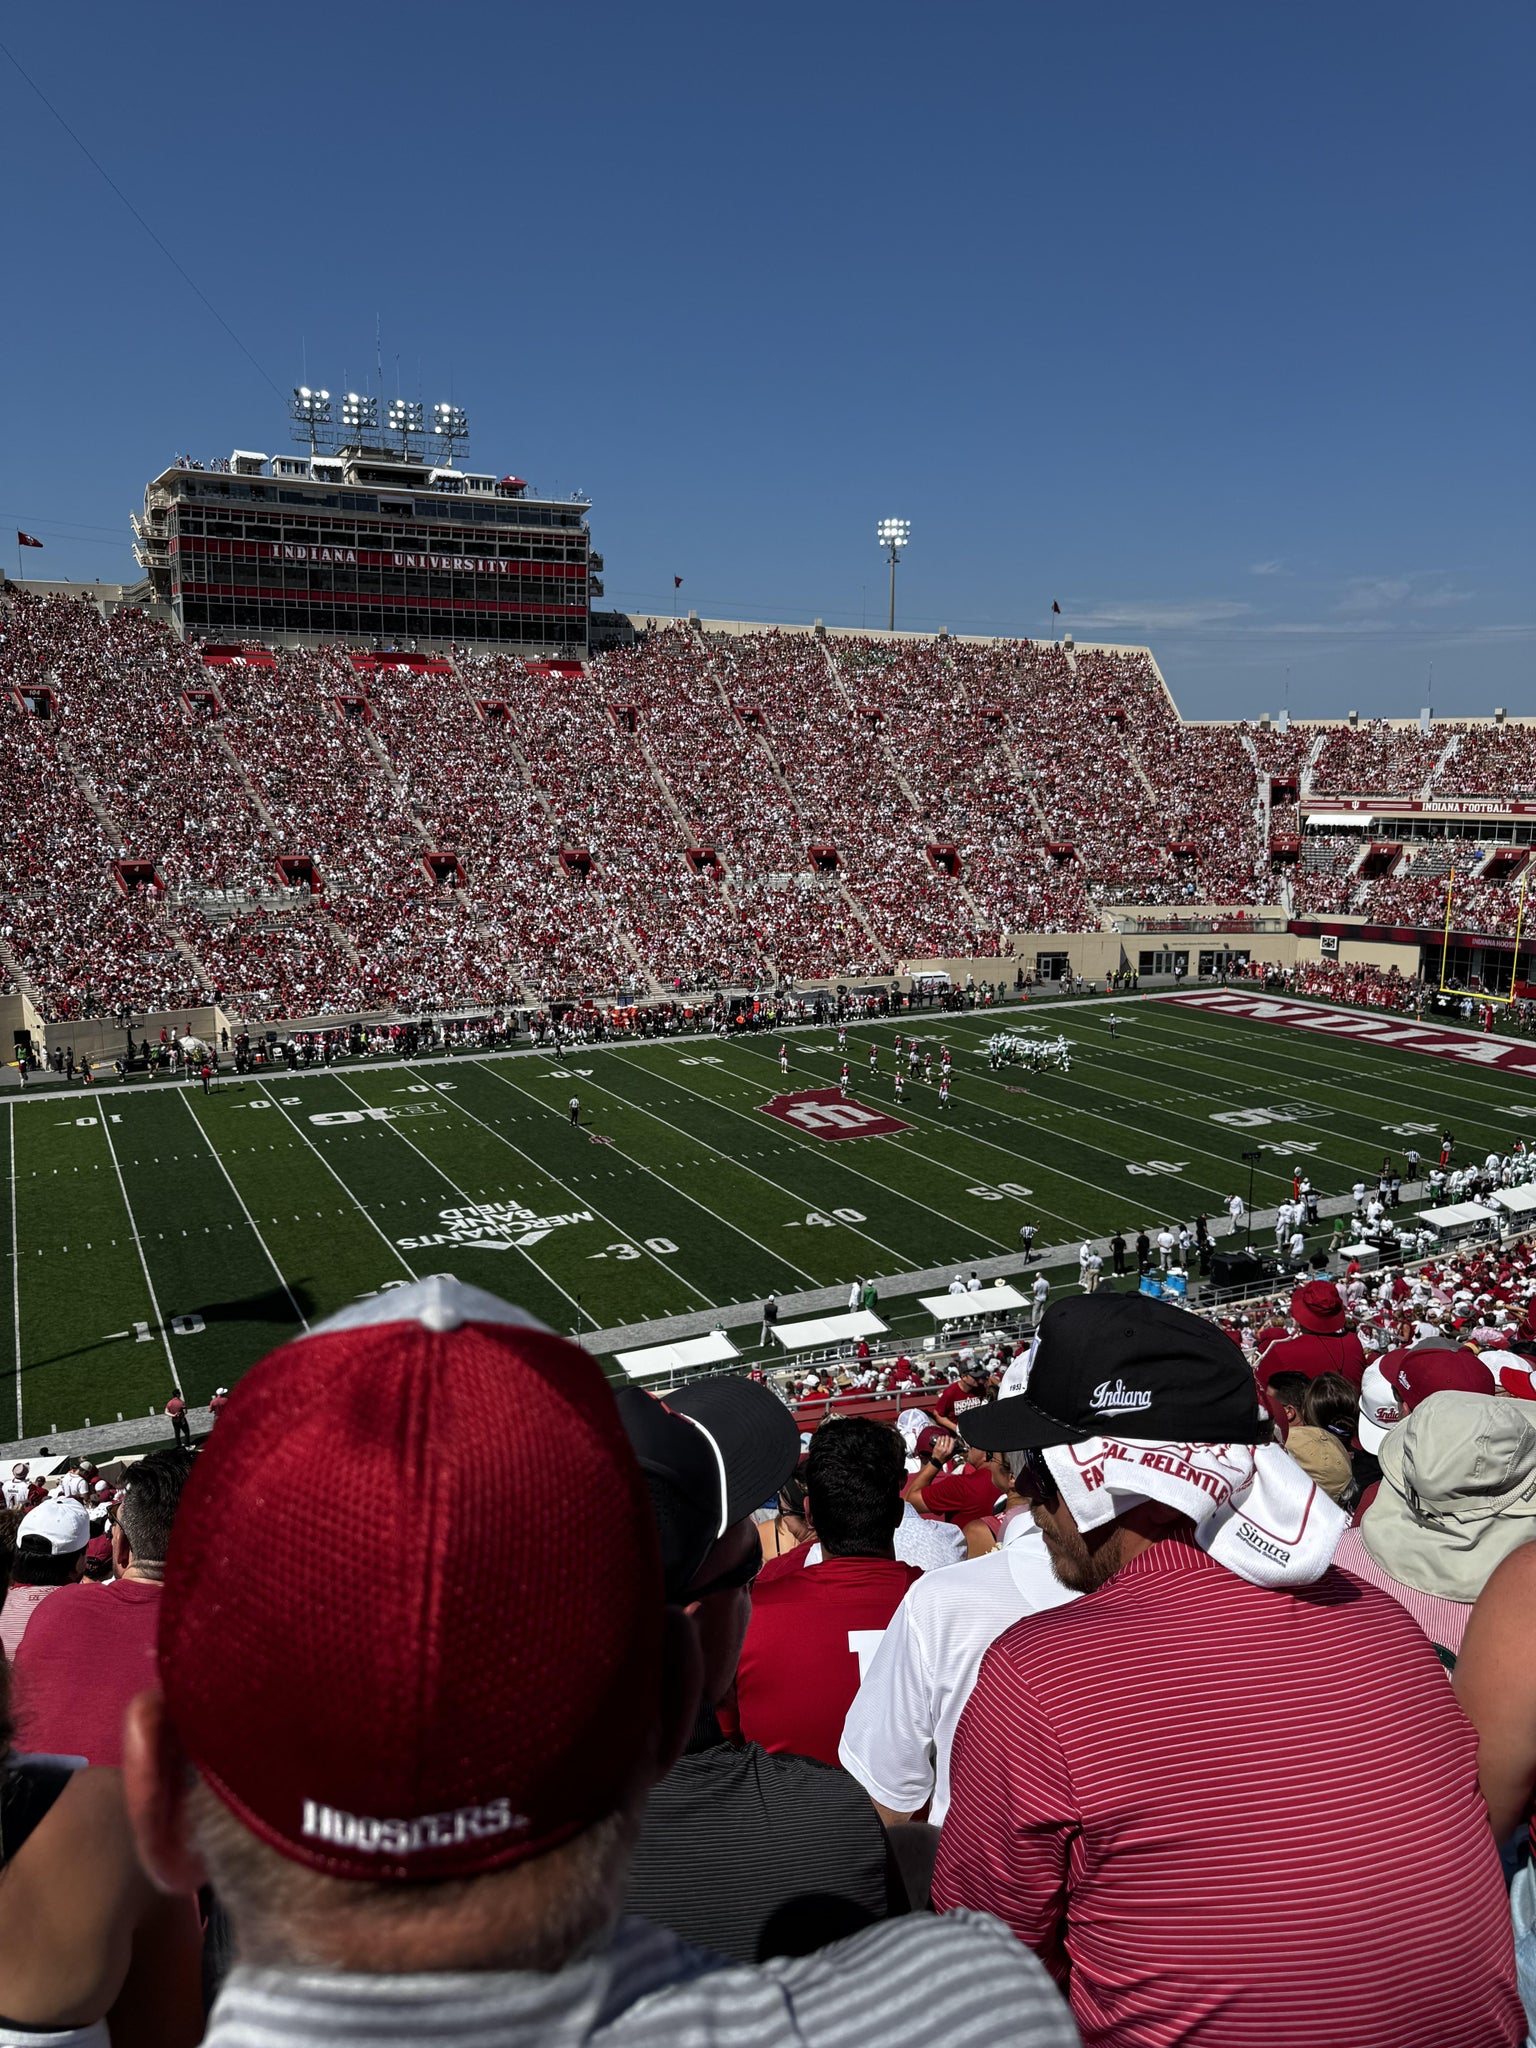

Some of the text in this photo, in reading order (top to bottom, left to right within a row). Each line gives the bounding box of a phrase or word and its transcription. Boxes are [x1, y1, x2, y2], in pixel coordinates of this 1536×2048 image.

[272, 544, 510, 573] INDIANA UNIVERSITY
[1422, 802, 1512, 813] INDIANA FOOTBALL
[1323, 938, 1335, 948] 25
[1472, 938, 1495, 947] INDIANA
[1175, 995, 1536, 1073] INDIA
[678, 1056, 724, 1065] 50
[550, 1069, 593, 1078] 40
[407, 1082, 458, 1093] 30
[249, 1097, 302, 1108] 20
[76, 1114, 123, 1126] 10
[1381, 1122, 1437, 1136] 20
[1257, 1140, 1317, 1155] 30
[1126, 1160, 1183, 1176] 40
[965, 1183, 1034, 1201] 50
[438, 1200, 522, 1218] FIELD
[806, 1208, 867, 1227] 40
[440, 1208, 538, 1231] BANK
[396, 1211, 594, 1250] MERCHANTS
[606, 1237, 680, 1260] 30
[132, 1314, 206, 1343] 10
[1089, 1378, 1152, 1409] Indiana
[1239, 1522, 1290, 1562] Simtra
[302, 1798, 510, 1853] HOOSIERS
